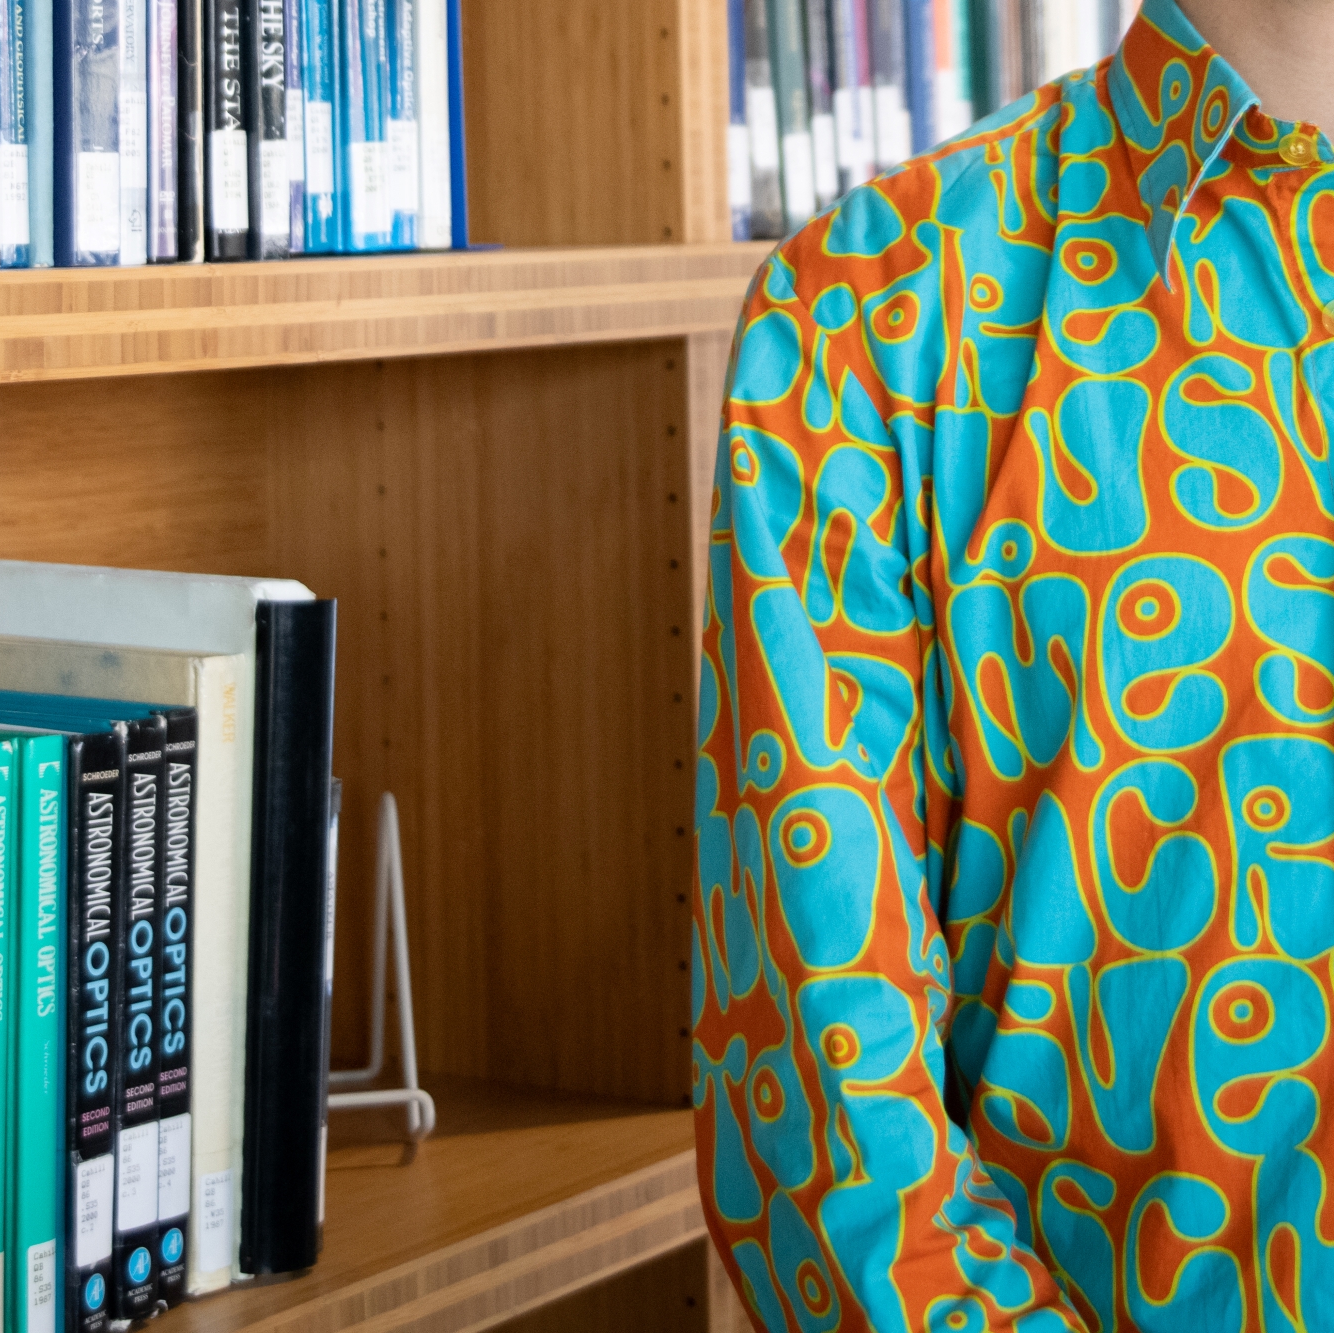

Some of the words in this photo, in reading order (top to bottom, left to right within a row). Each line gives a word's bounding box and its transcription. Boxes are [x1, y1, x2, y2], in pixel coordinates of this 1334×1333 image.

[224, 7, 240, 71] THE
[260, 41, 285, 92] SKY
[82, 768, 120, 782] SCHROEDER
[127, 750, 162, 763] SCHROEDER
[36, 788, 59, 940] ASTRONOMICAL
[86, 792, 114, 942] ASTRONOMICAL
[131, 773, 157, 920] ASTRONOMICAL
[166, 762, 191, 907] ASTRONOMICAL
[35, 945, 57, 1018] OPTICS
[85, 942, 110, 1094] OPTICS
[129, 921, 154, 1069] OPTICS
[164, 907, 187, 1054] OPTICS
[81, 1106, 111, 1123] SECOND
[82, 1121, 109, 1137] EDITION
